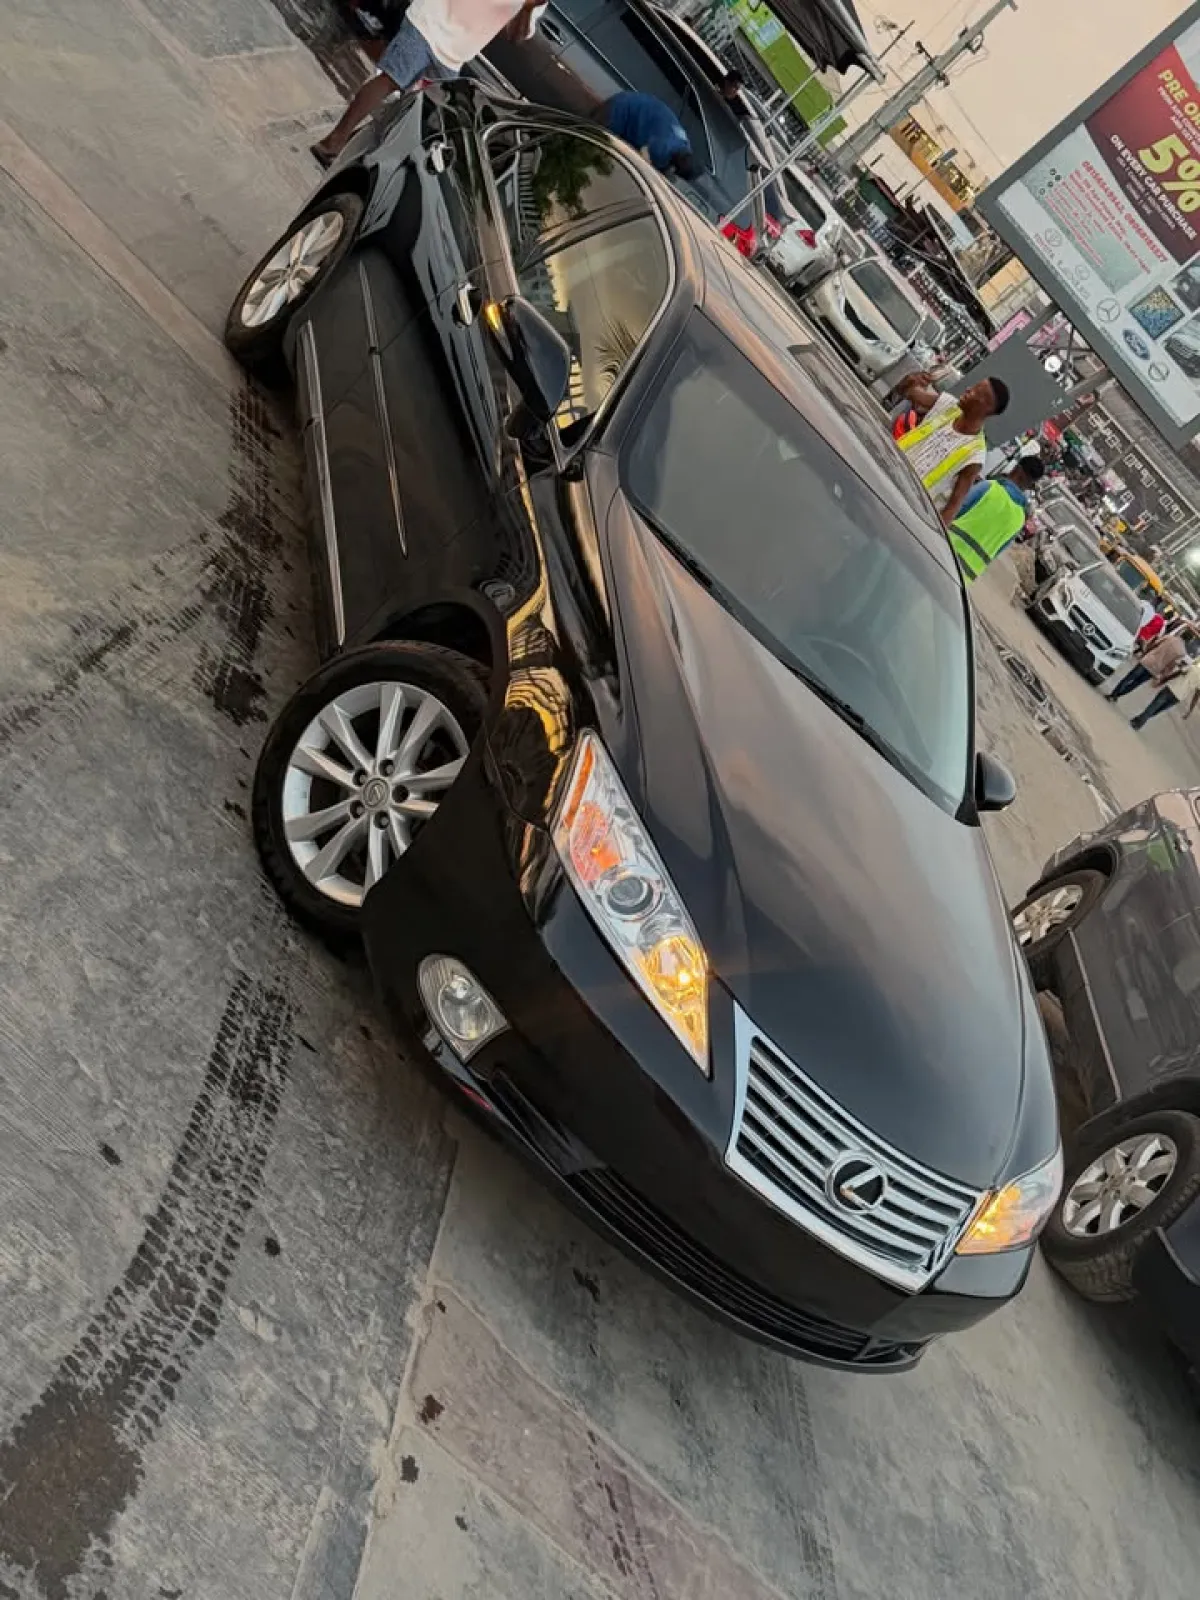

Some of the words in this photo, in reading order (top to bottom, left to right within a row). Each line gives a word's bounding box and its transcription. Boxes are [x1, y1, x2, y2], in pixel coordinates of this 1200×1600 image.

[1158, 70, 1188, 102] PRE
[1110, 134, 1125, 150] ON
[1120, 148, 1147, 178] EVERY
[1143, 175, 1162, 196] CAR
[1157, 193, 1198, 240] PURCHASE
[1137, 133, 1200, 213] 5%
